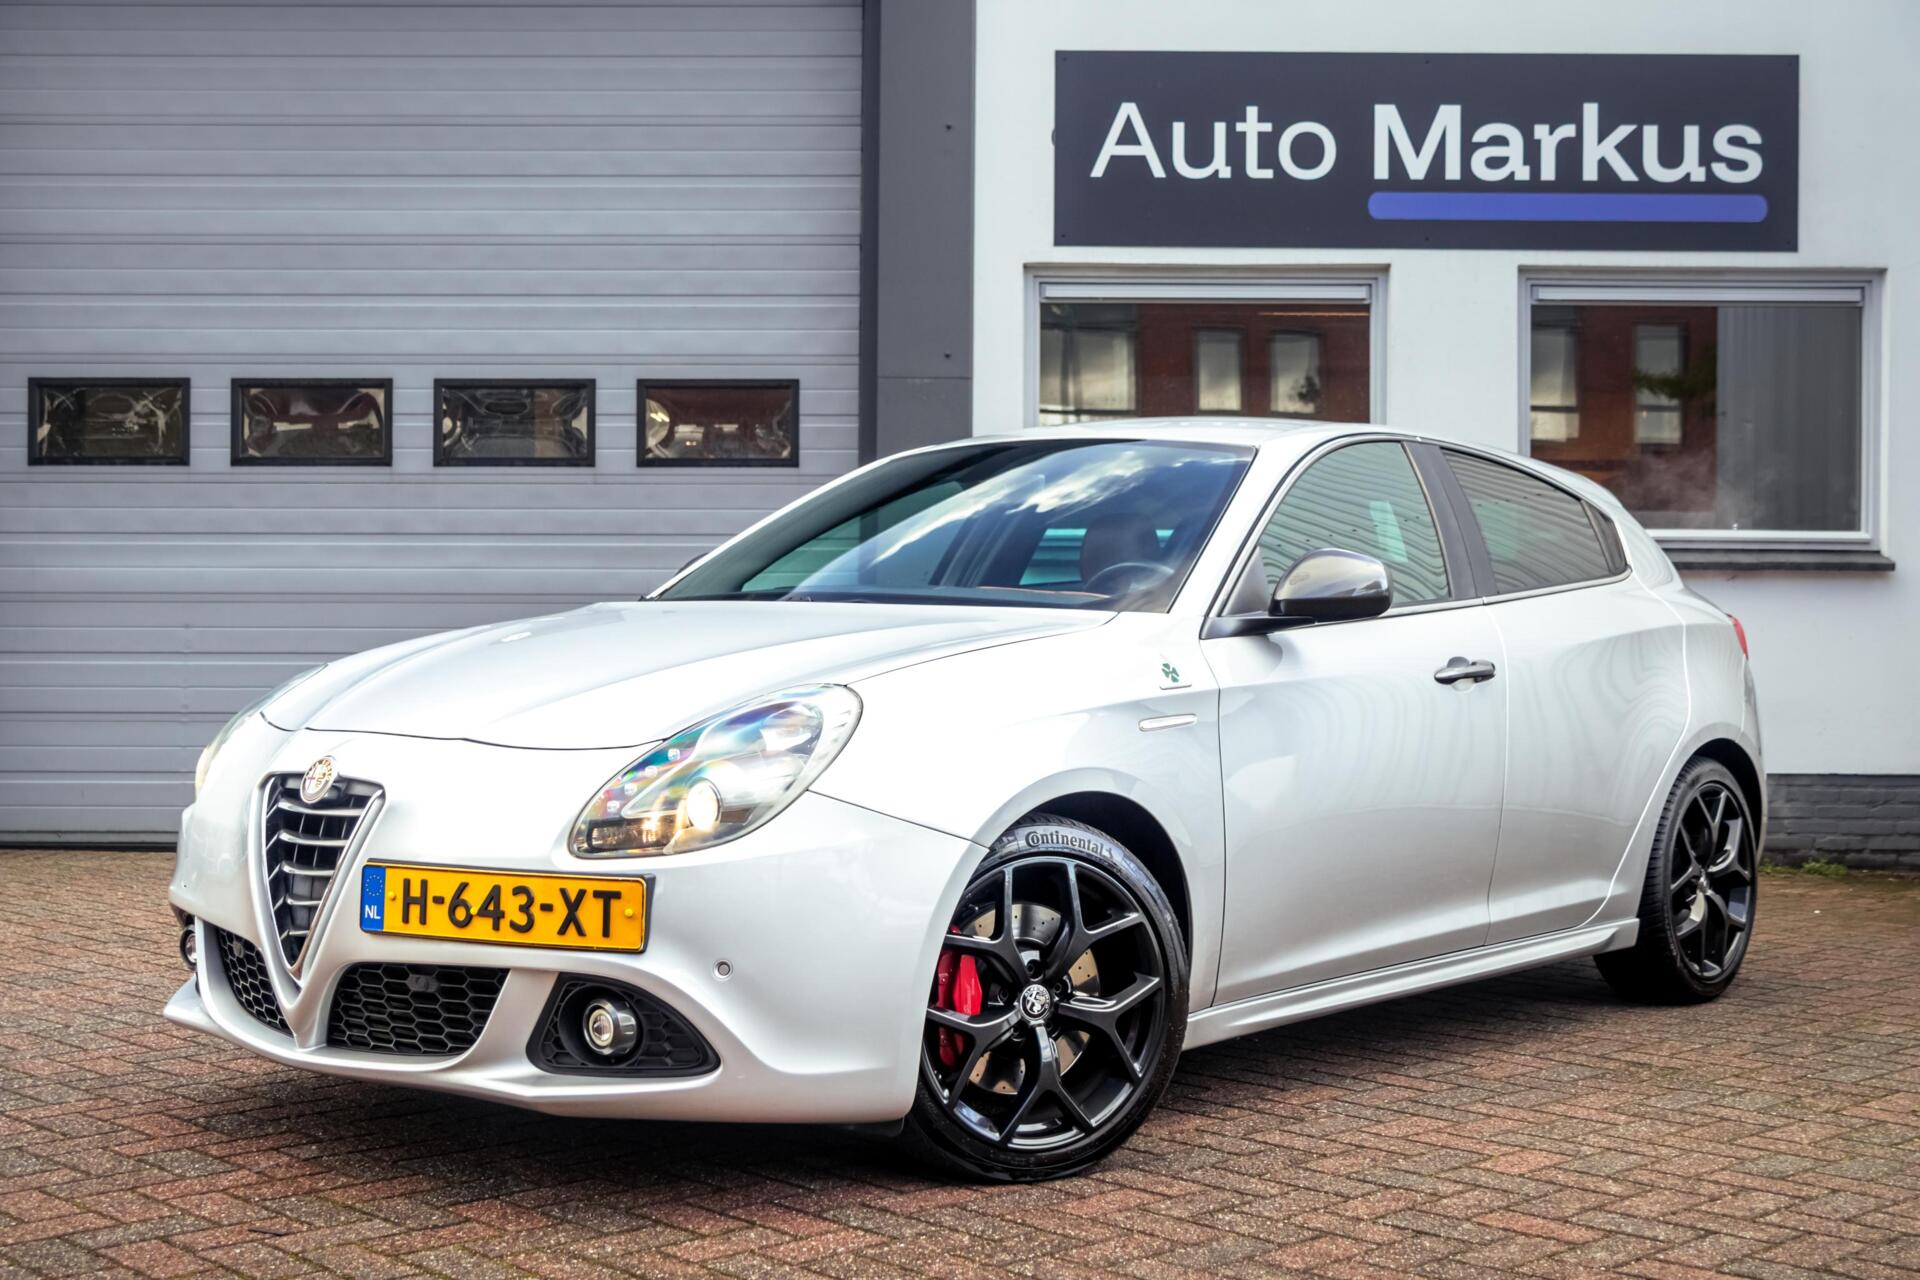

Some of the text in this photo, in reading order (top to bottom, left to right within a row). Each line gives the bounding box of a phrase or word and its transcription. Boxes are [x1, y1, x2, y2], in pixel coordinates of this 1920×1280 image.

[1090, 102, 1764, 183] Auto Markus
[1025, 831, 1105, 857] Continental
[364, 904, 381, 919] NL
[402, 878, 622, 938] H-643-XT
